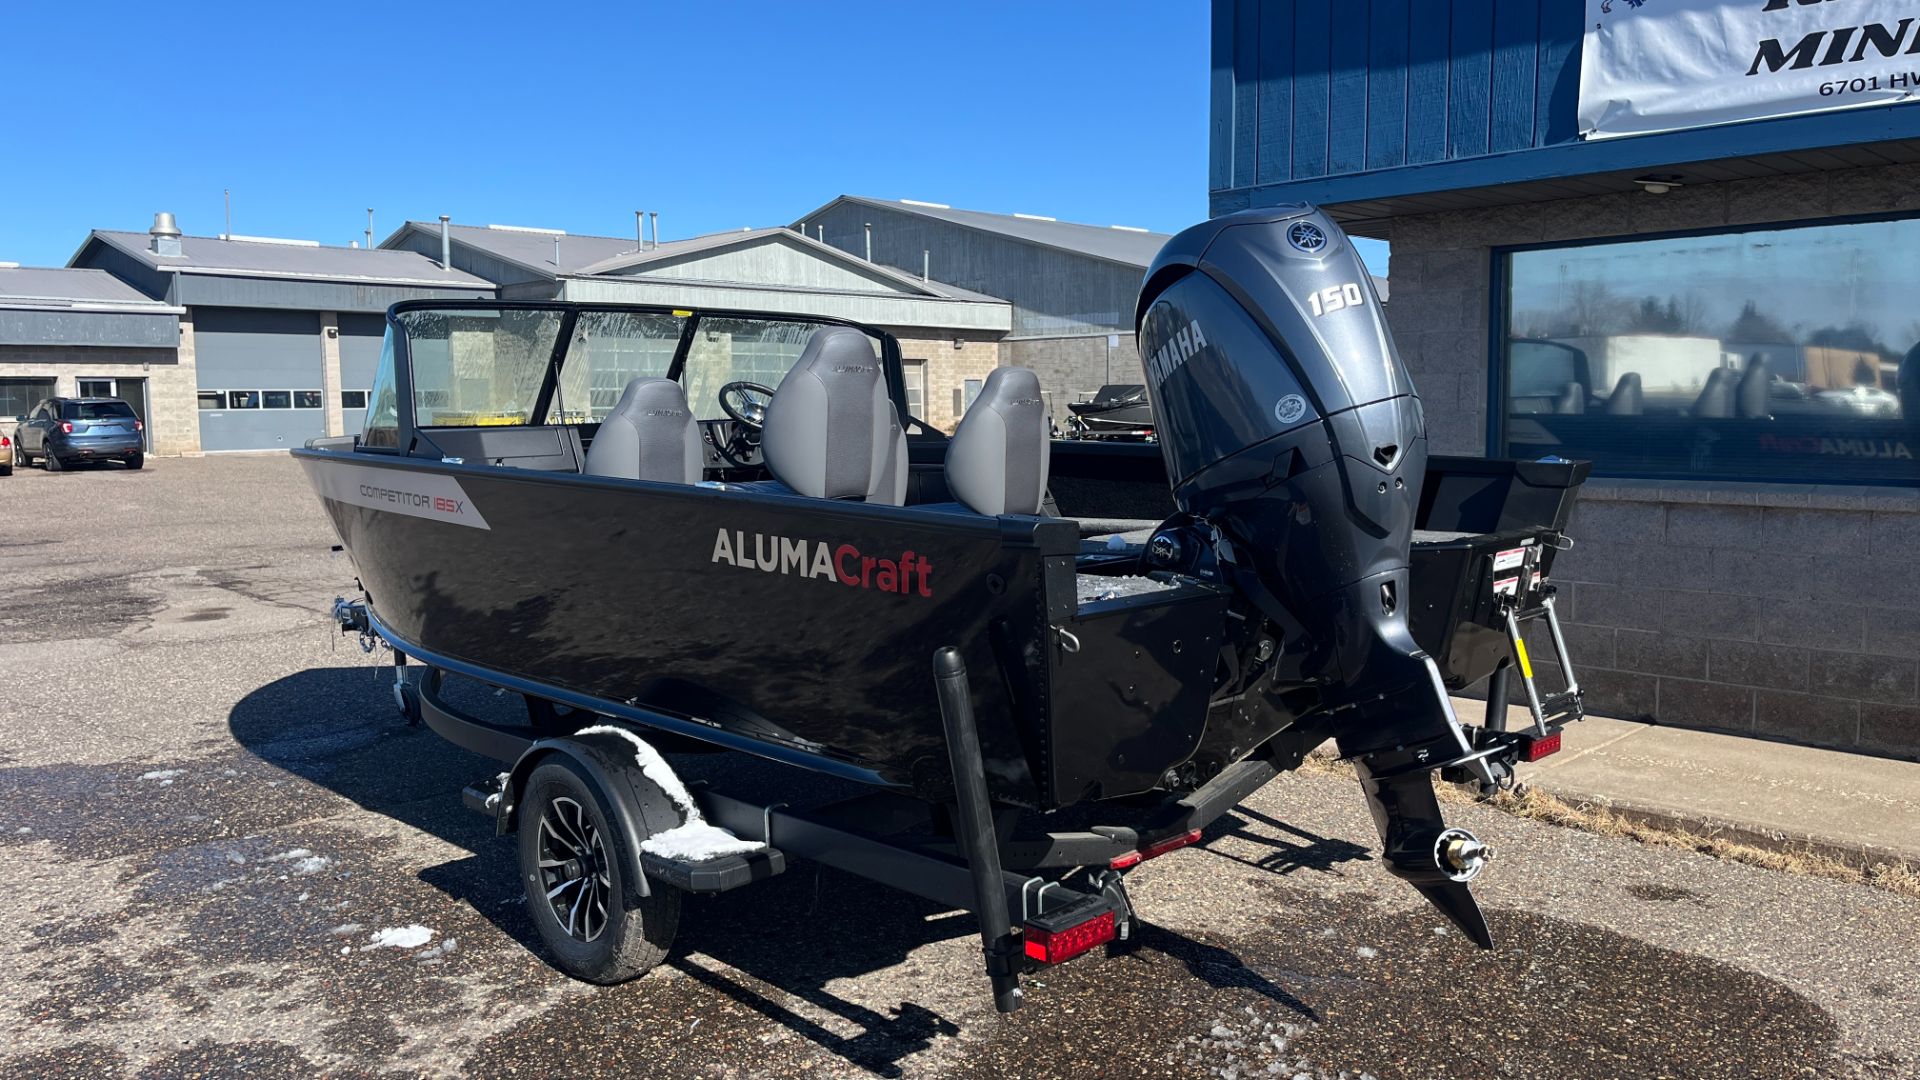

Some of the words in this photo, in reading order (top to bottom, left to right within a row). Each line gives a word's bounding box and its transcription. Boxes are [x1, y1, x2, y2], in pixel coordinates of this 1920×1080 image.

[1818, 76, 1881, 96] 6701
[1307, 282, 1363, 317] 150
[1149, 319, 1208, 391] YAMAHA
[359, 484, 430, 508] COMPETITOR
[711, 528, 933, 597] ALUMACraft
